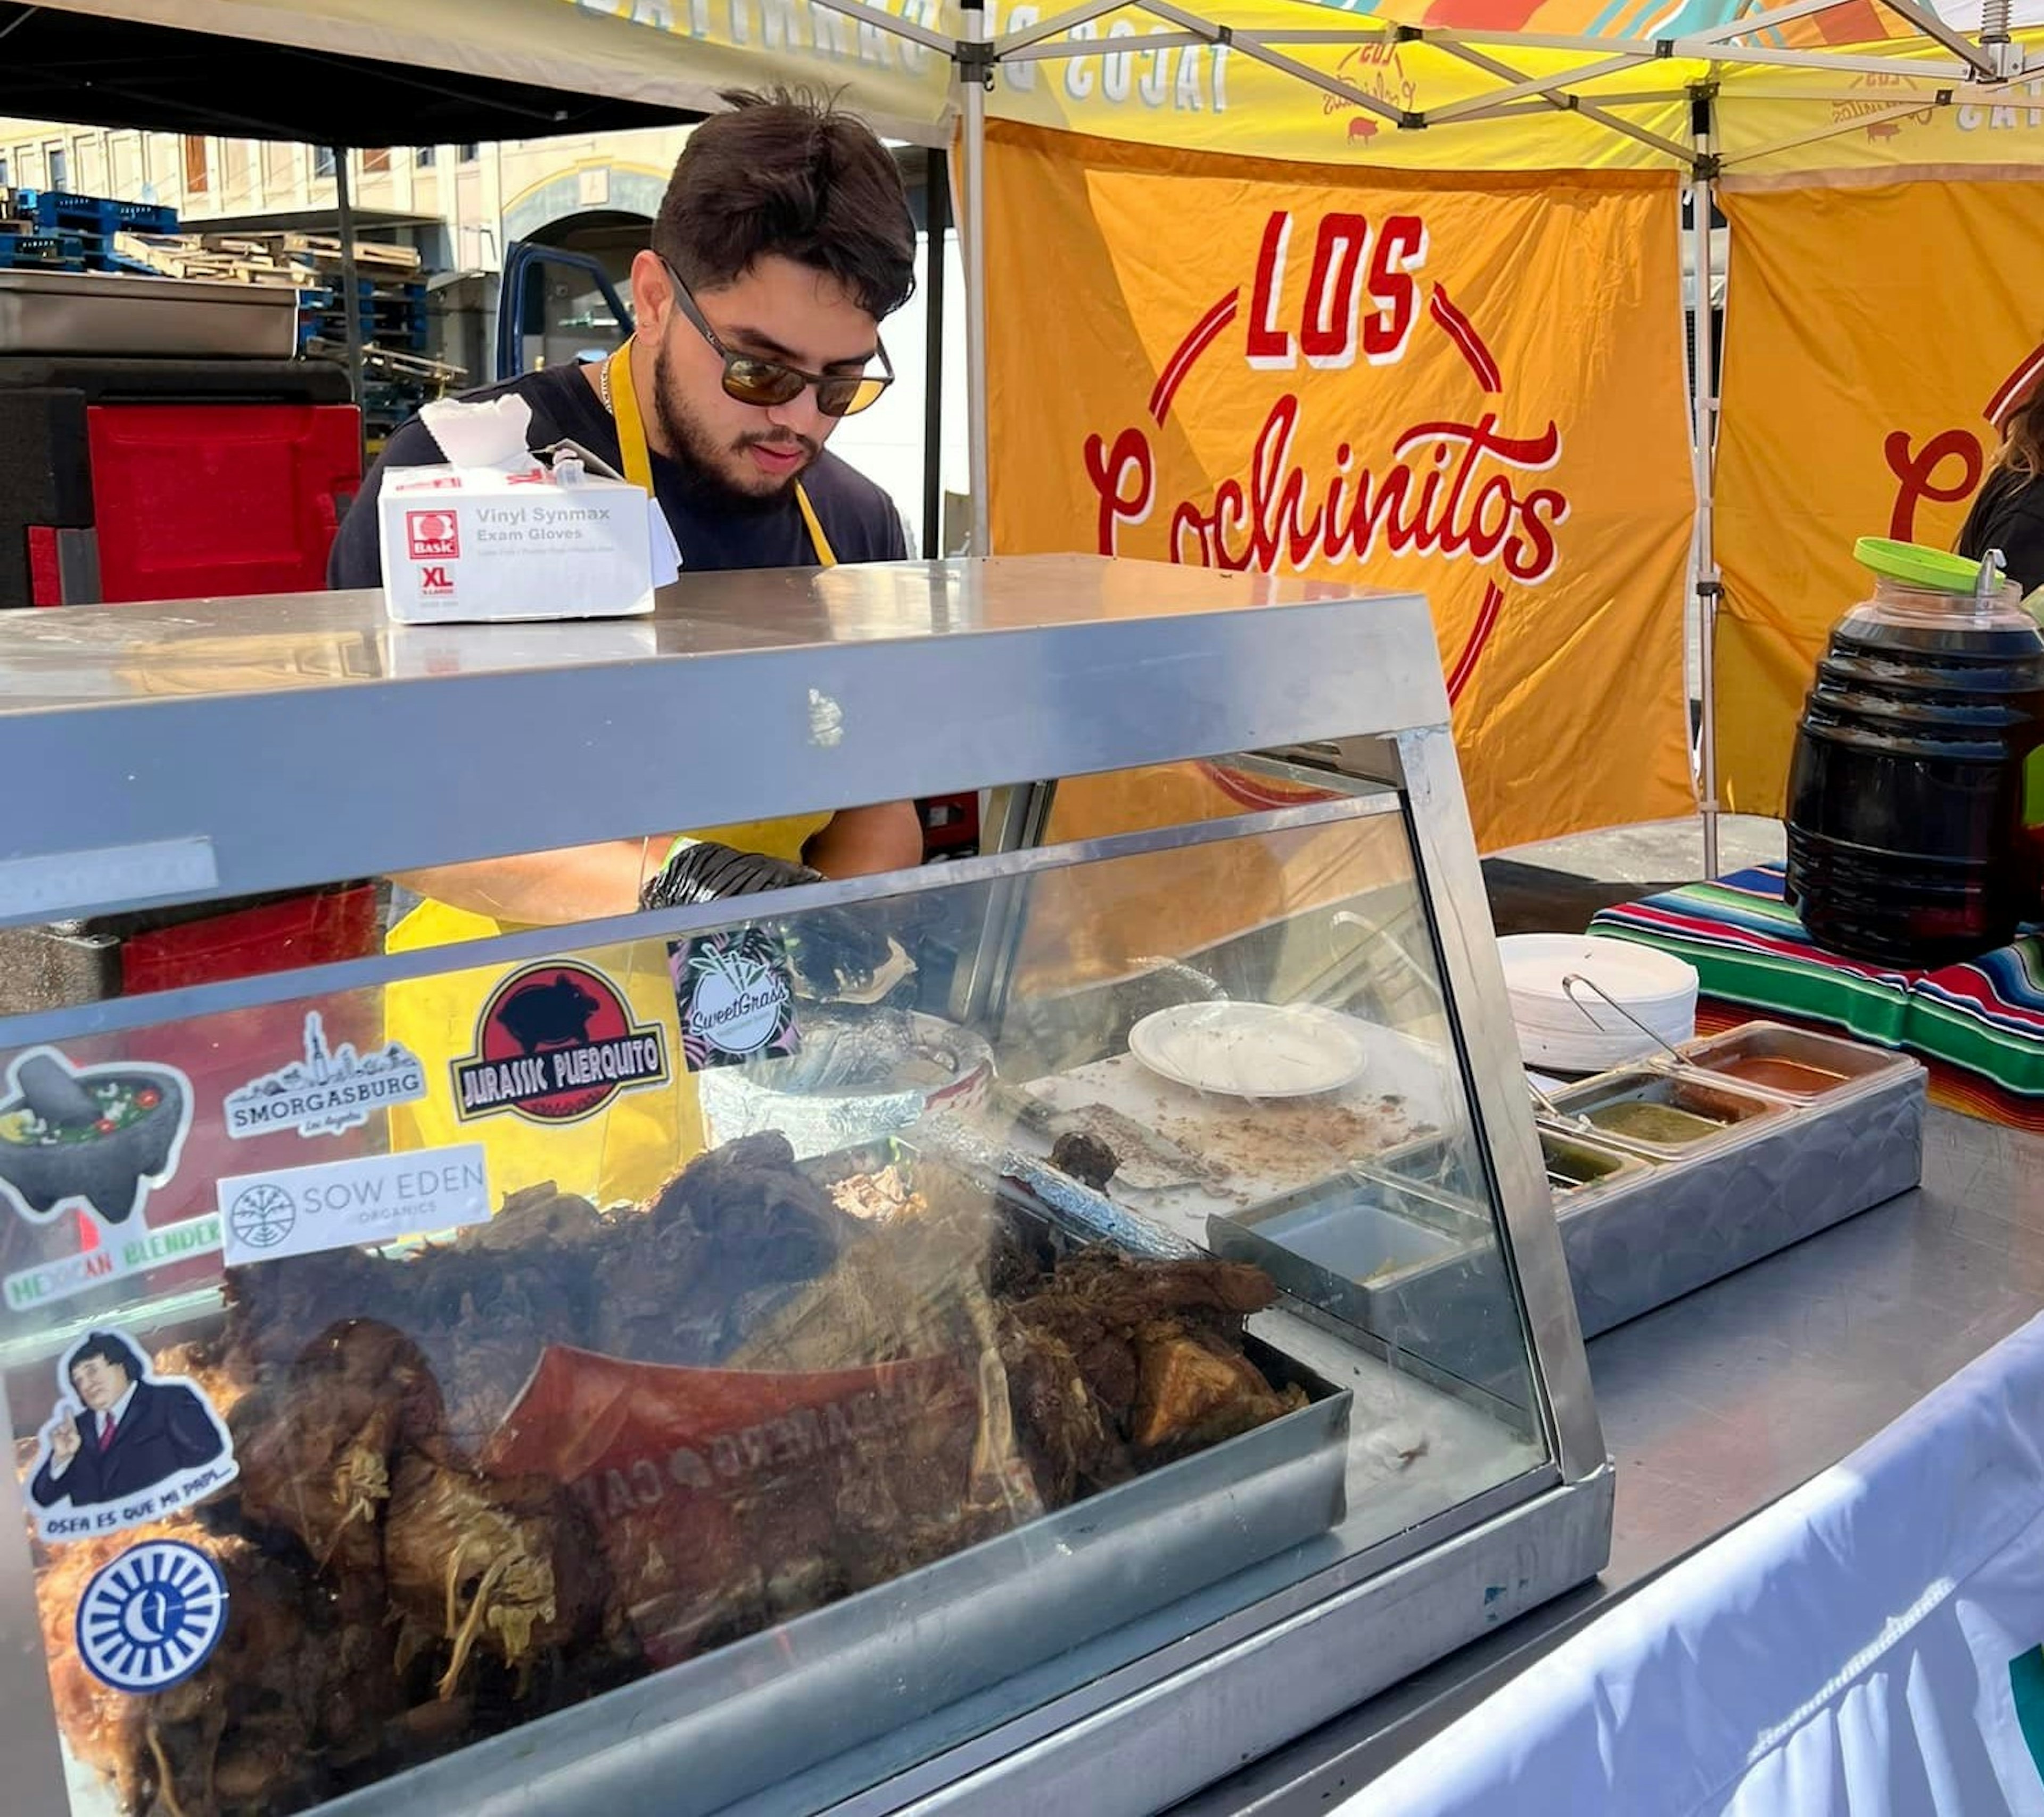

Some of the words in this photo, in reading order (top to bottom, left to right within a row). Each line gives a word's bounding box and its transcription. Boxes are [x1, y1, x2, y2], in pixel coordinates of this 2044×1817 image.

[1245, 211, 1429, 369] LOS
[476, 507, 526, 526] Vinyl
[532, 506, 611, 524] Synmax
[477, 528, 524, 541] Exam
[529, 527, 583, 540] Gloves
[422, 567, 454, 587] XL
[692, 977, 787, 1034] SweetGrass
[462, 1056, 548, 1108] JURASSIC
[553, 1037, 658, 1088] PUERQUITO
[234, 1073, 421, 1127] SMORGASBURG
[302, 1178, 384, 1214] SOW
[396, 1161, 484, 1200] EDEN
[359, 1202, 437, 1223] ORGANICS
[47, 1517, 90, 1533] OSEA
[96, 1511, 118, 1528] ES
[122, 1499, 154, 1521] QUE
